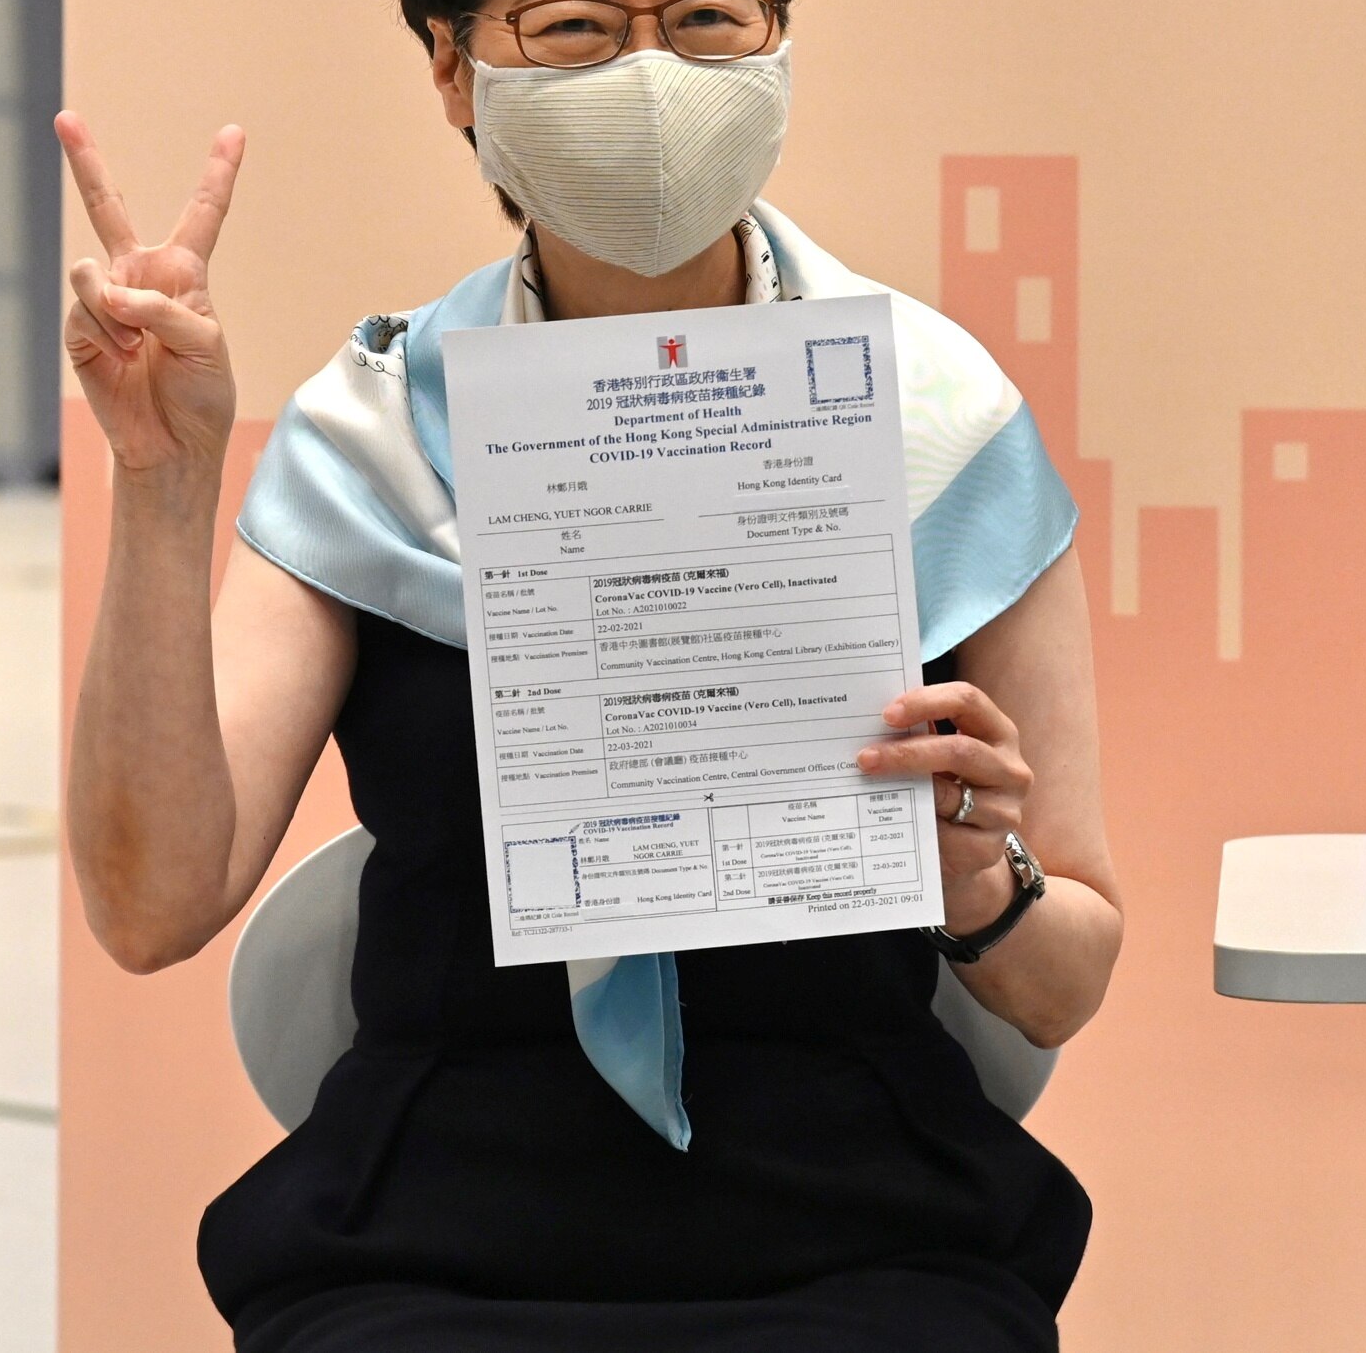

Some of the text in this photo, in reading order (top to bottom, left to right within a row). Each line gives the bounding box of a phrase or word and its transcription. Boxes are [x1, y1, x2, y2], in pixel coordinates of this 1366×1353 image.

[586, 398, 613, 410] 2019
[614, 406, 741, 428] Department of Health
[485, 413, 872, 454] The Government of the Hong Kong Special Administrative Region
[589, 439, 772, 463] COVID-19 Vaccination Record
[738, 473, 842, 490] Hong Kong Identity Card
[489, 503, 652, 525] LAM CHENG, YUET NGOR CARRIE
[561, 530, 582, 541] 姓名
[747, 523, 841, 539] Document Type & No.
[560, 546, 585, 555] Name
[595, 576, 837, 603] CoronaVac COVID-19 Vaccine (Vero Cell), Inactivated
[596, 602, 687, 616] Lot No. A2021010022
[598, 622, 643, 633] 22-02-2021
[601, 638, 899, 671] Community Vaccination Centre, Hong Kong Central Library (Exhibition Gallery)
[605, 694, 847, 722] CoronaVac COVID-19 Vaccine (Vero Cell), Inactivated
[606, 720, 697, 735] Lot No. A2021010034
[607, 740, 653, 752] 22-03-2021
[611, 778, 654, 789] Community
[656, 773, 701, 786] Vaccination
[703, 772, 729, 782] Centre,
[731, 769, 758, 779] Central
[760, 766, 806, 776] Government
[808, 763, 835, 772] Offices
[632, 844, 651, 852] LAM
[680, 840, 699, 848] YUET
[634, 849, 683, 860] NGOR CARRIE
[807, 894, 924, 914] Printed on 22-03-2021 09:01
